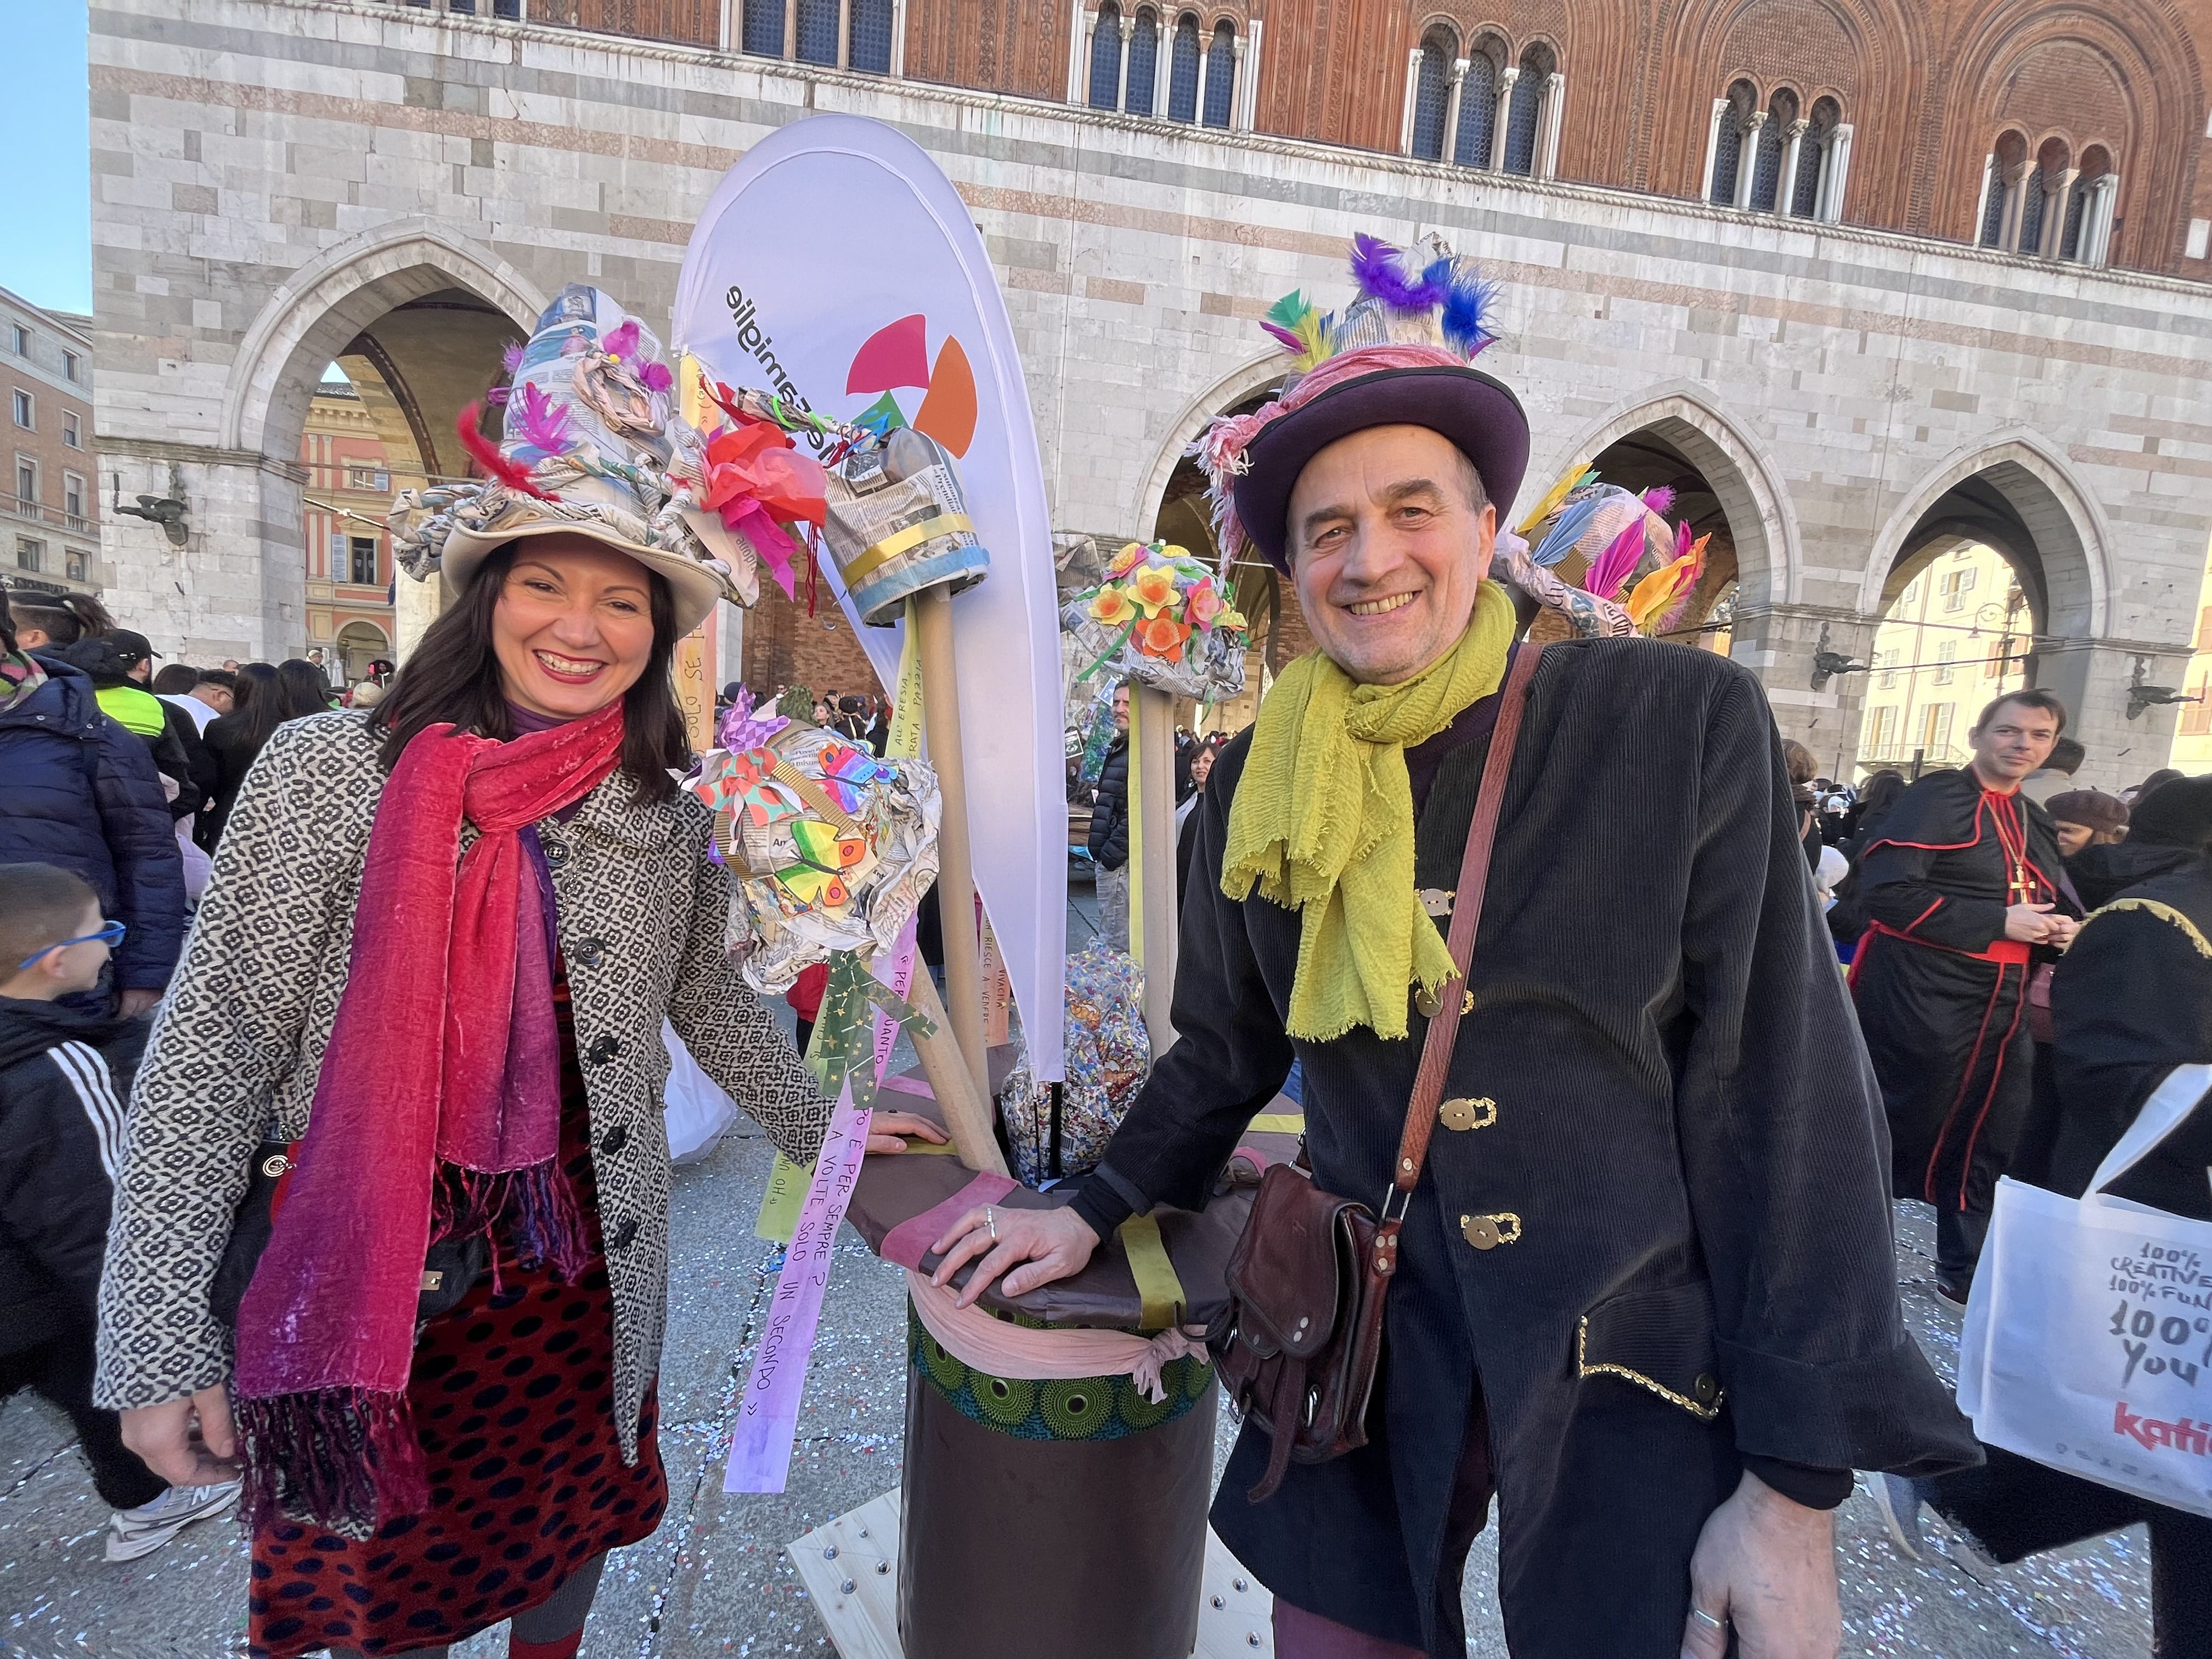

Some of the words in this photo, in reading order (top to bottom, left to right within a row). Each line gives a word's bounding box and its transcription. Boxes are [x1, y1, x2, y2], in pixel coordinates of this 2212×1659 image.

[684, 657, 703, 681] SE
[685, 696, 702, 739] SOLO
[983, 936, 992, 969] RIESCE
[894, 971, 907, 1001] PER
[876, 1018, 894, 1065] UANTO
[827, 1130, 844, 1142] A
[836, 1163, 856, 1198] PER
[792, 1221, 815, 1262] SOLO
[814, 1204, 842, 1261] SEMPRE
[2111, 1256, 2212, 1288] CREATIVE
[2139, 1242, 2202, 1271] 100%
[779, 1282, 799, 1301] UN
[2109, 1274, 2157, 1302] 100%
[2159, 1285, 2212, 1311] FUN
[757, 1314, 791, 1390] SECONDO
[2121, 1338, 2199, 1389] You
[2114, 1401, 2212, 1457] kati
